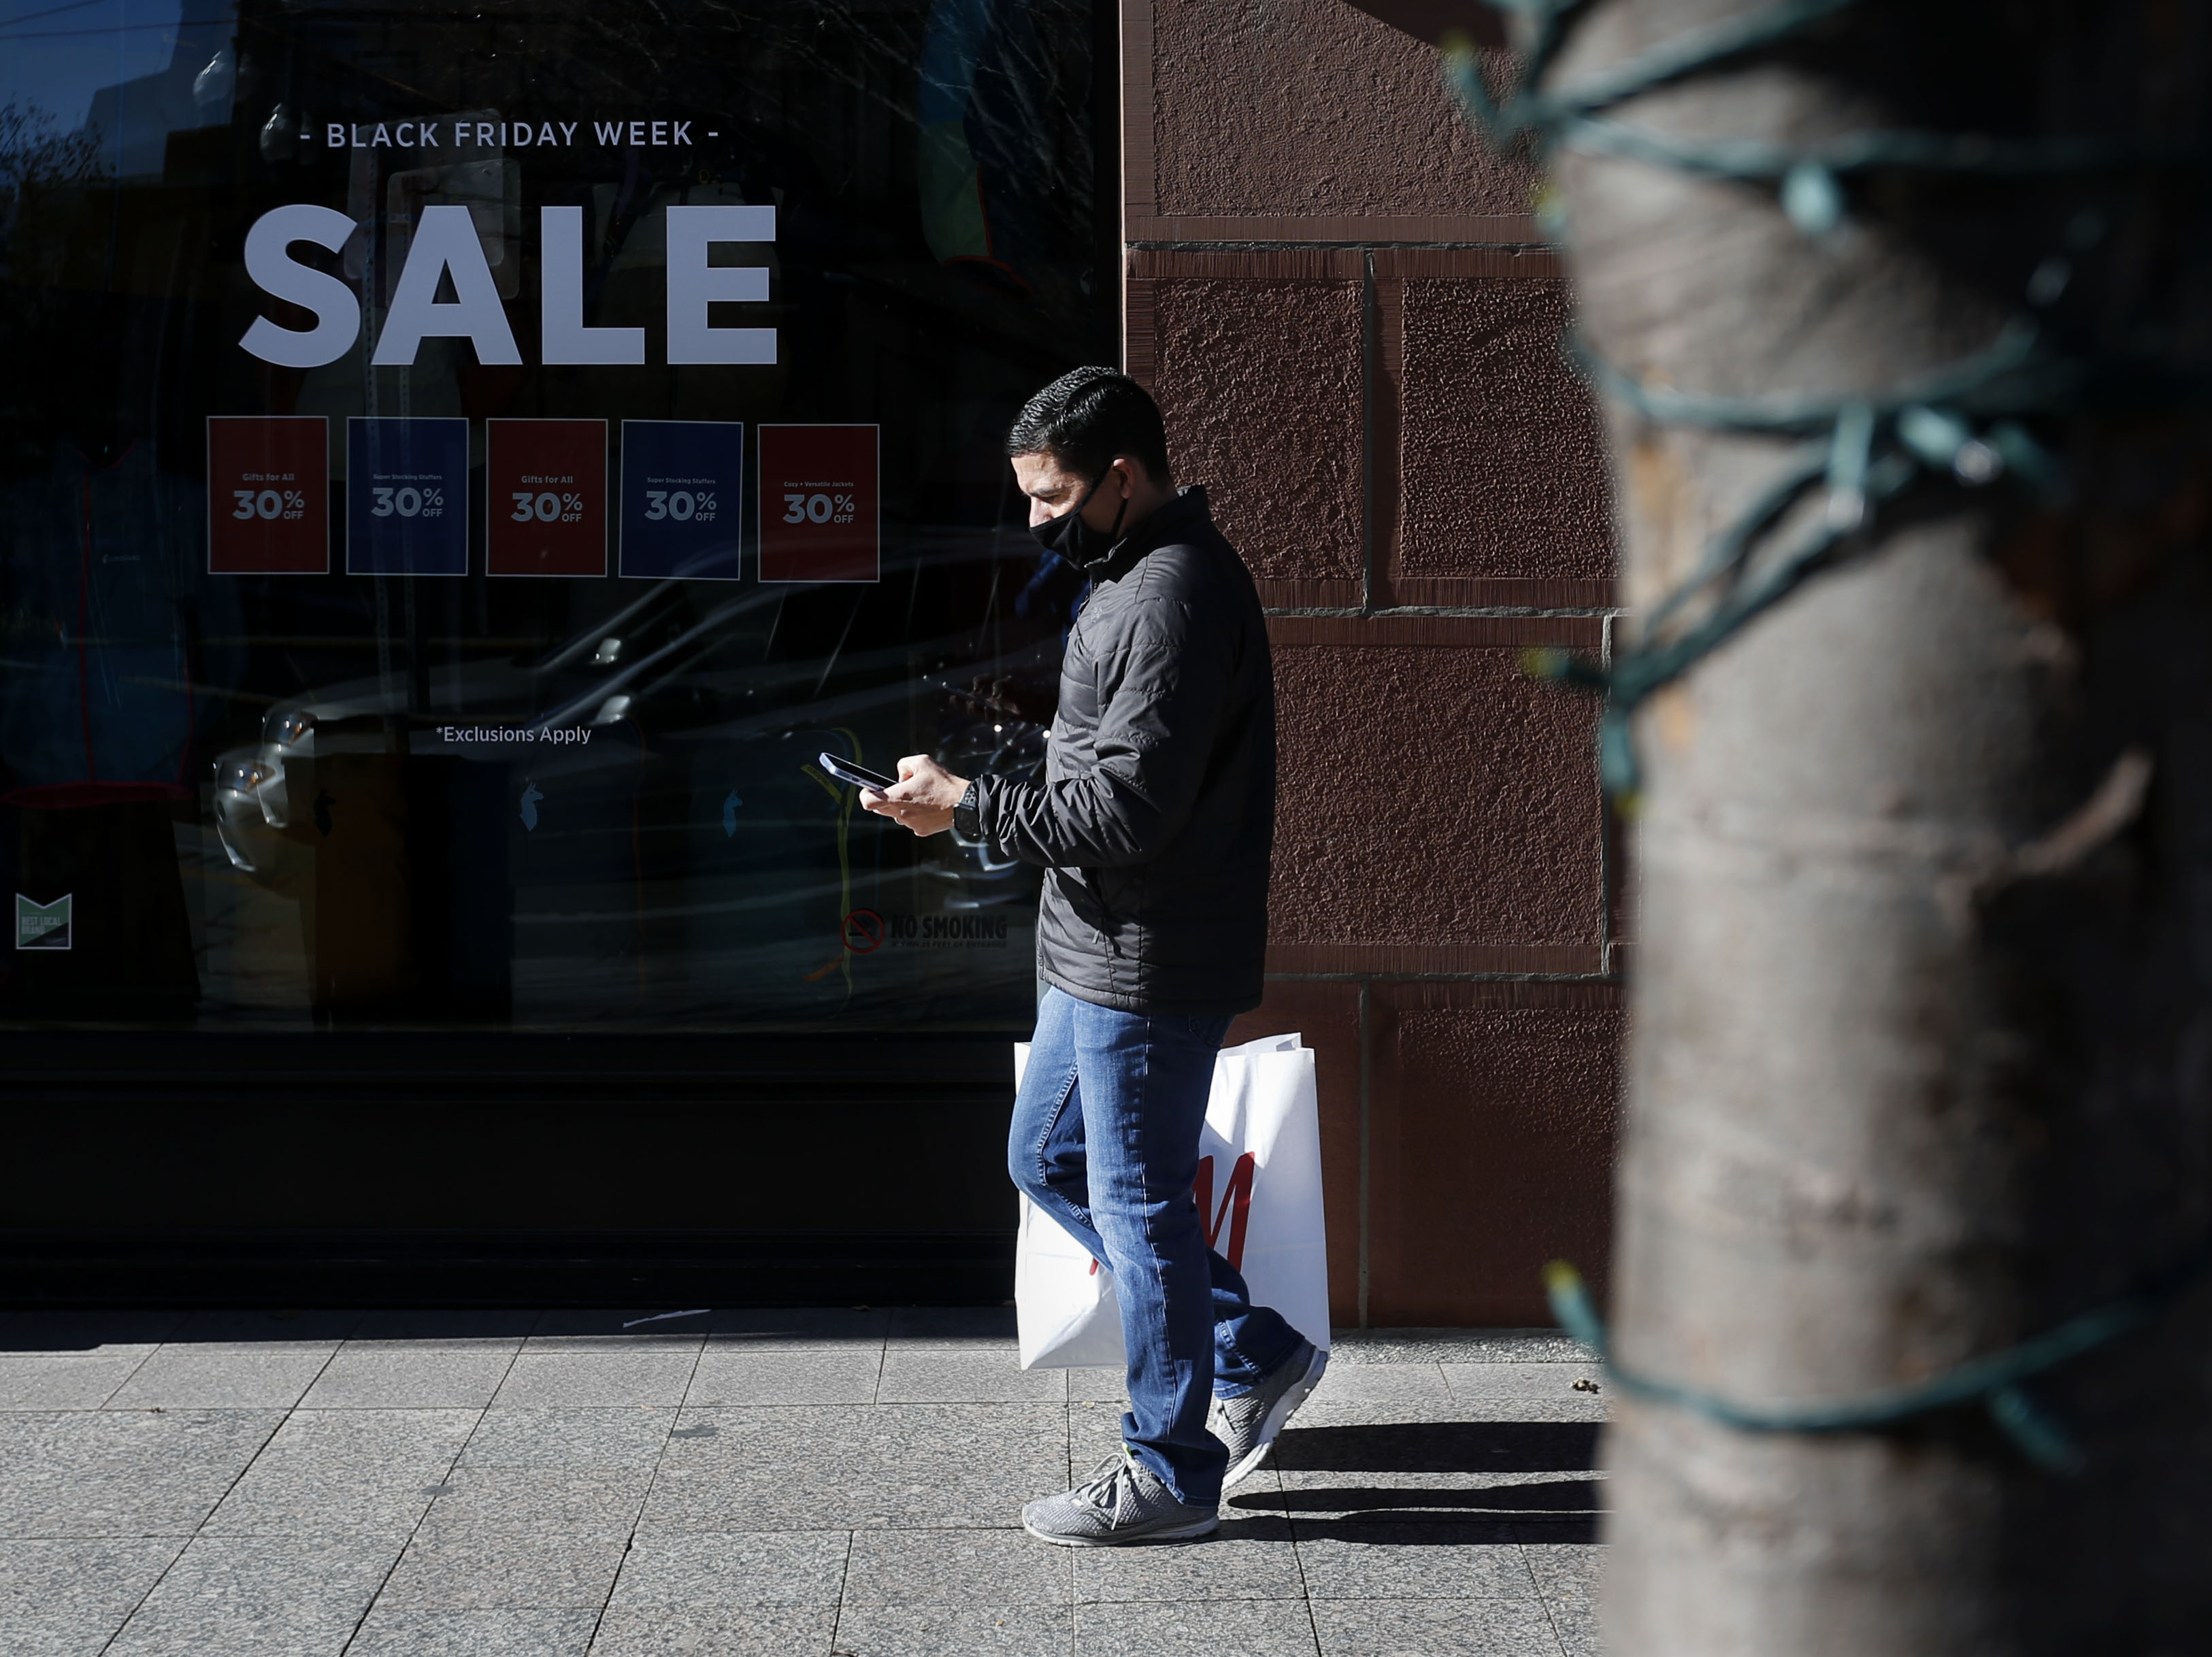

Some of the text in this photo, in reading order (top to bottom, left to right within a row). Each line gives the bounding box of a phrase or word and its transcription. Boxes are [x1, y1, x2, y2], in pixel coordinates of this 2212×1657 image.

[327, 122, 440, 148] BLACK
[455, 122, 579, 147] FRIDAY
[593, 121, 693, 146] WEEK
[238, 204, 777, 367] SALE
[521, 475, 574, 484] Gifts for All
[233, 490, 305, 520] 30%
[371, 487, 444, 517] 30%
[423, 508, 443, 517] OFF
[510, 492, 583, 522] 30%
[644, 490, 716, 520] 30%
[782, 494, 855, 523] 30%
[283, 510, 304, 520] OFF
[562, 514, 582, 522] OFF
[695, 513, 716, 521] OFF
[833, 515, 855, 523] OFF
[540, 726, 591, 744] Apply
[892, 914, 1008, 939] NO SMOKING
